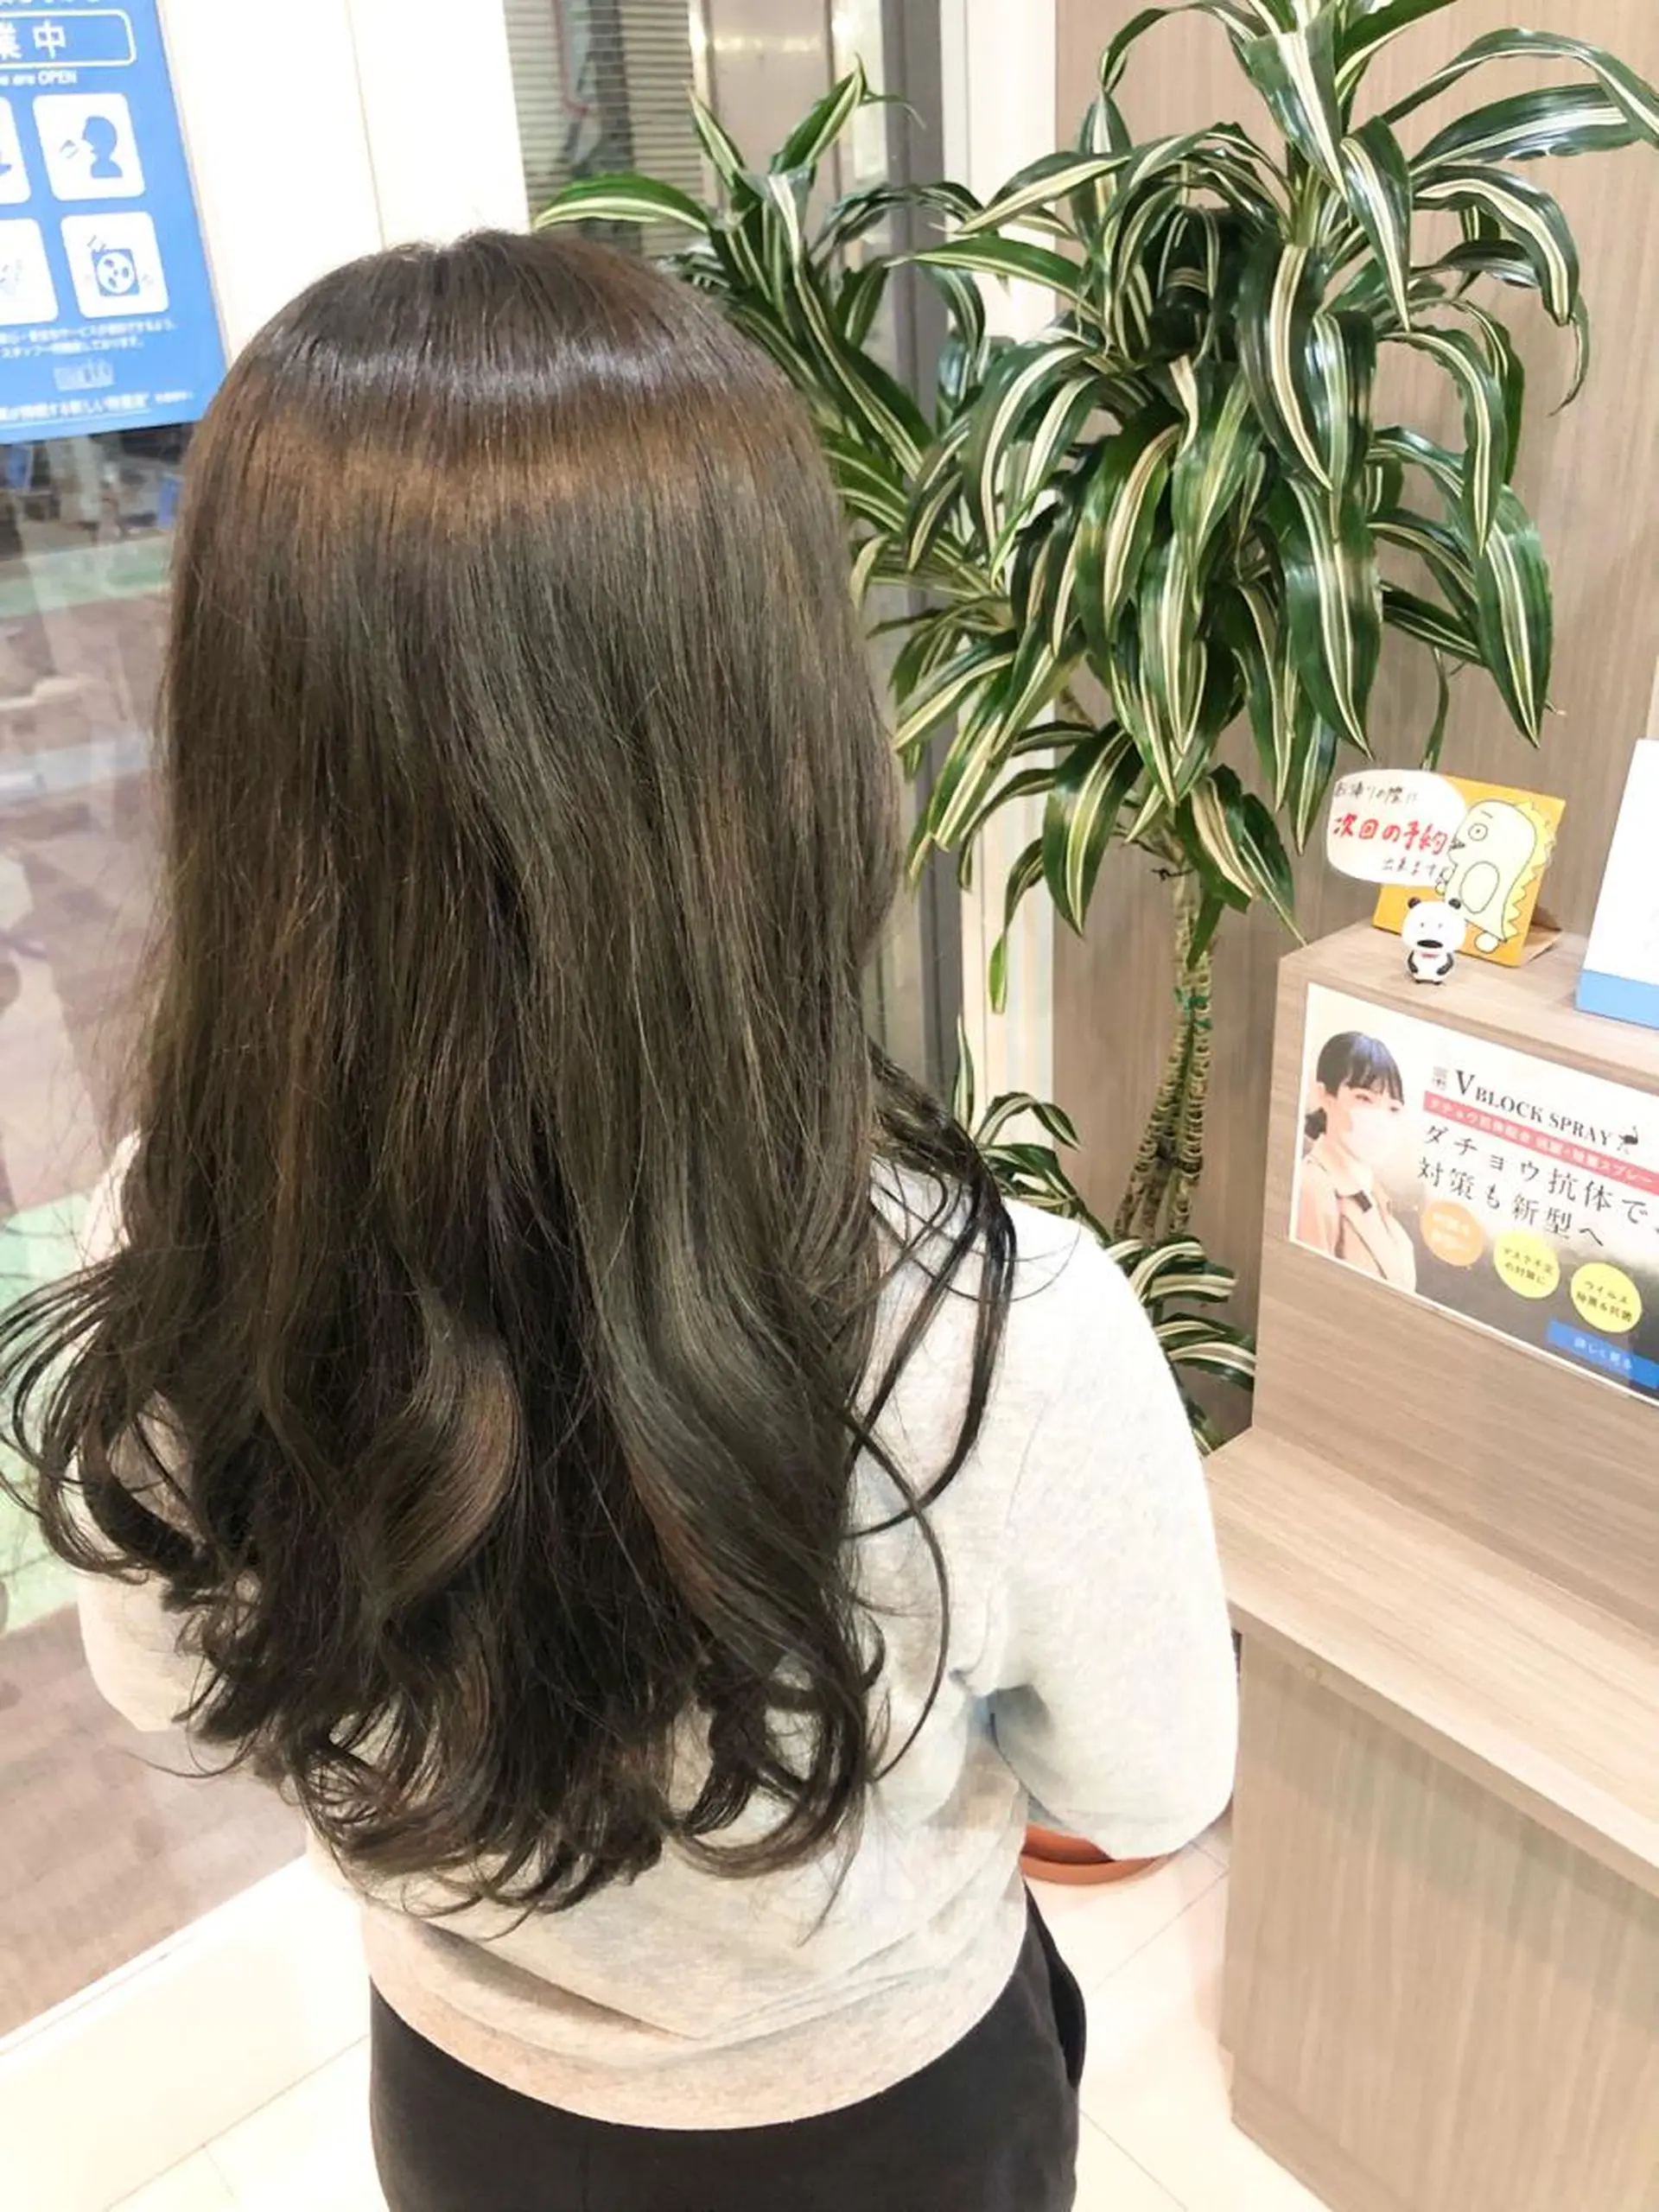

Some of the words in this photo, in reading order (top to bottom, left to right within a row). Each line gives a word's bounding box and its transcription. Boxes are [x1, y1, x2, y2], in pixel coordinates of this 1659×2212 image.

[38, 69, 77, 85] OPEN
[1333, 813, 1448, 855] 次回の予約
[1548, 1112, 1611, 1147] SPRAY
[1418, 1156, 1604, 1247] 対策も新型へ
